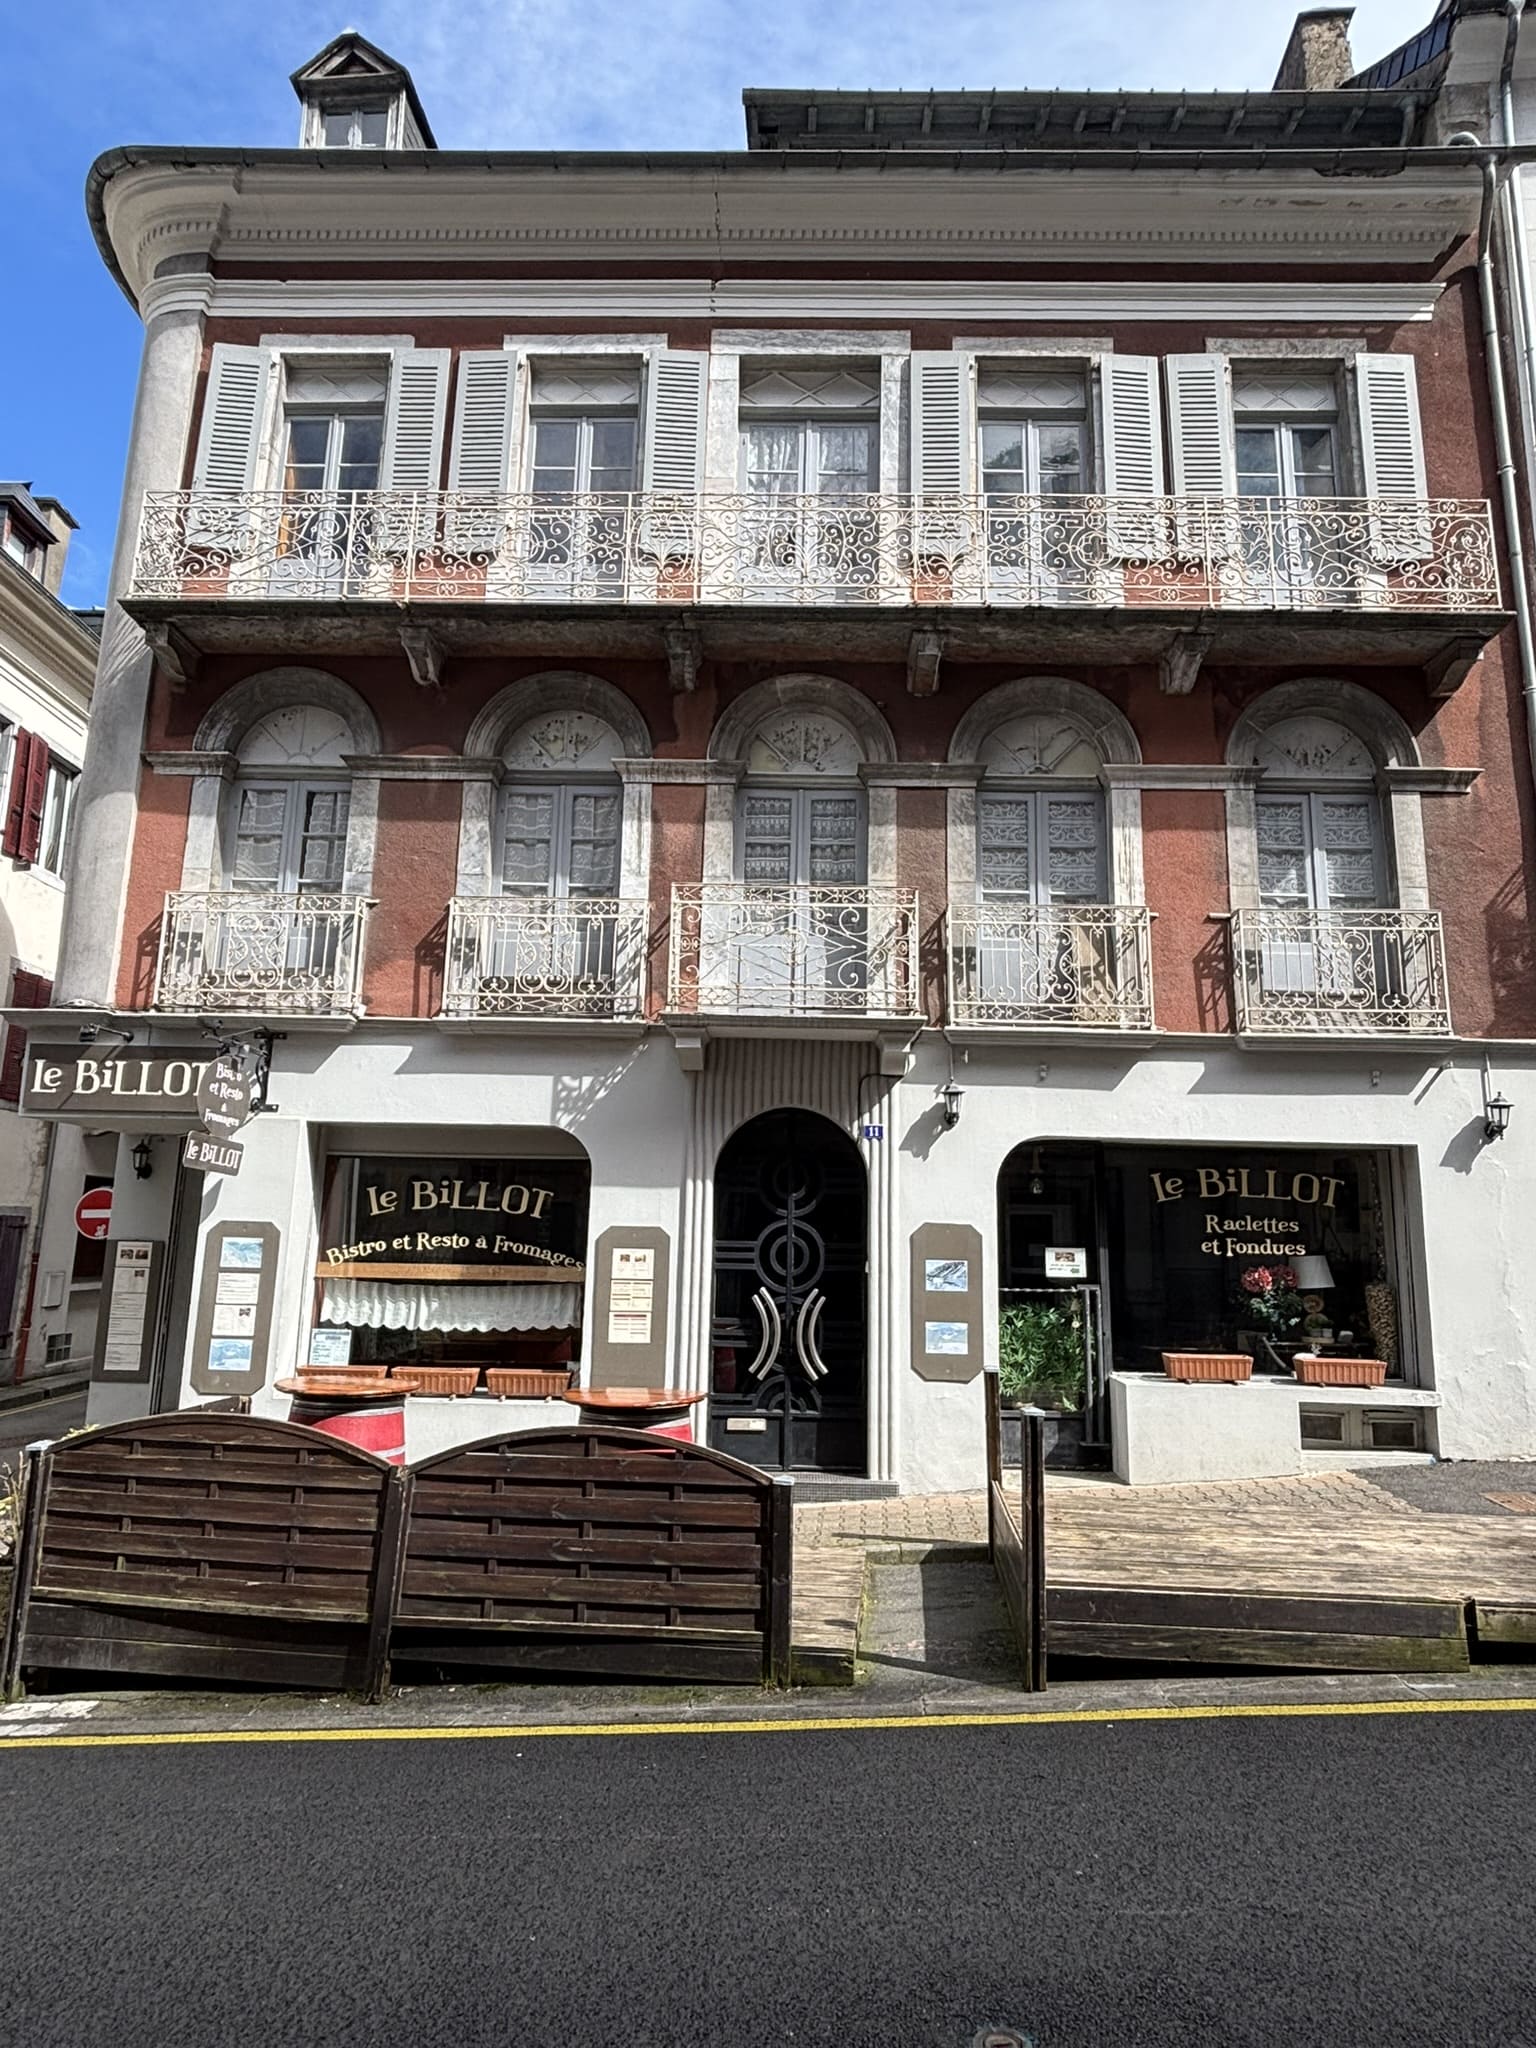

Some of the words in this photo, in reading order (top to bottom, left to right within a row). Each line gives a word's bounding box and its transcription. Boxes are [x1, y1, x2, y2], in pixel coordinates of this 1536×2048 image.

[31, 1059, 62, 1093] Le
[209, 1082, 219, 1095] et
[220, 1083, 243, 1100] Resto
[204, 1108, 240, 1127] Fromages
[869, 1126, 879, 1137] 11
[187, 1139, 199, 1160] Le
[200, 1142, 242, 1169] BiLLOT
[367, 1185, 399, 1216] Le
[411, 1180, 553, 1219] BiLLOT
[1150, 1172, 1185, 1203] Le
[1196, 1168, 1345, 1208] BiLLOT
[1205, 1214, 1300, 1234] Raclettes
[326, 1239, 387, 1267] Bistro
[392, 1234, 412, 1250] et
[416, 1231, 470, 1251] Resto
[475, 1234, 488, 1249] à
[494, 1234, 586, 1272] Fromages
[1201, 1239, 1222, 1256] et
[1226, 1238, 1306, 1257] Fondues
